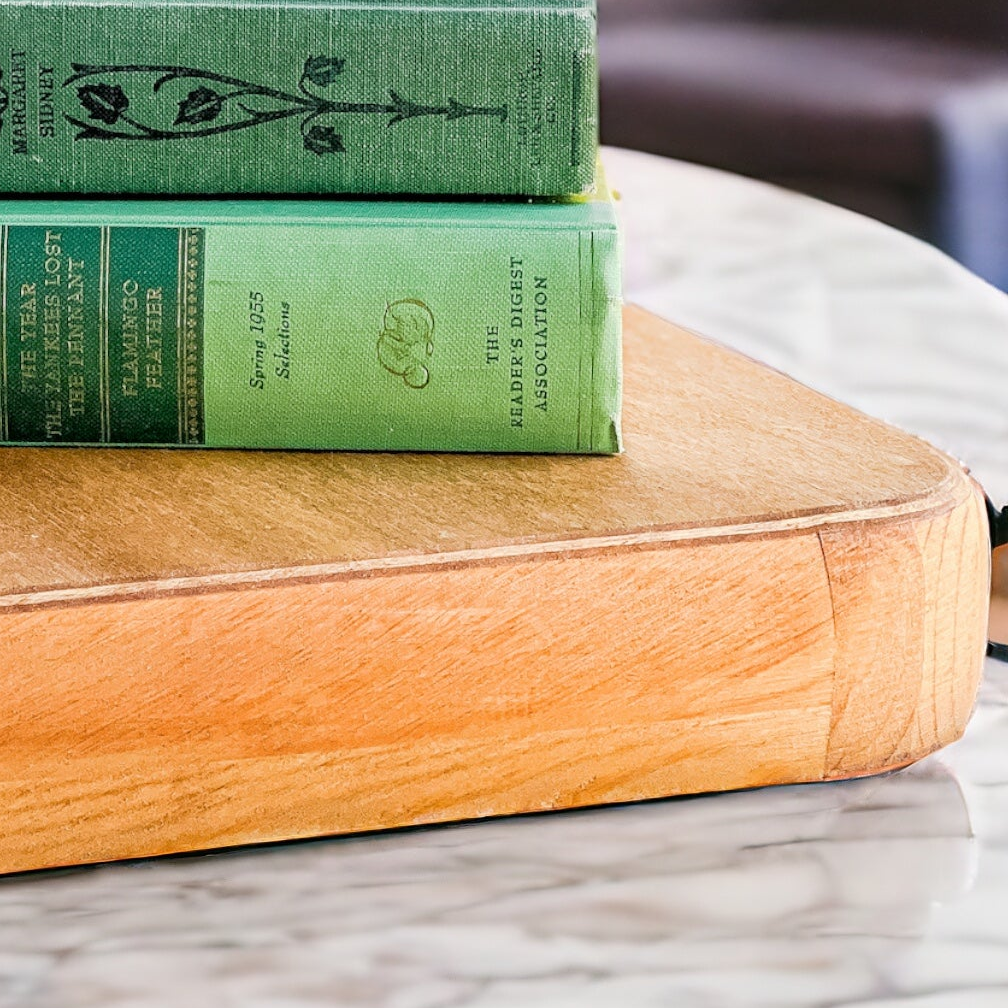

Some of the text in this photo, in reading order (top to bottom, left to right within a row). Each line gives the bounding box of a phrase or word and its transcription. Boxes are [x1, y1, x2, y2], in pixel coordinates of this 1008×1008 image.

[10, 49, 27, 155] MARGARET
[39, 67, 54, 139] SIDNEY
[20, 282, 36, 342] YEAR
[45, 230, 62, 439] THE YANKEES LOST
[68, 257, 85, 417] THE PENNANT
[122, 279, 140, 397] FLAMINGO
[146, 286, 163, 389] FEATHER
[249, 292, 264, 390] Spring 1955
[275, 301, 291, 380] Selections
[486, 324, 499, 364] THE
[510, 256, 524, 429] READER'S DIGEST
[533, 276, 548, 412] ASSOCIATION
